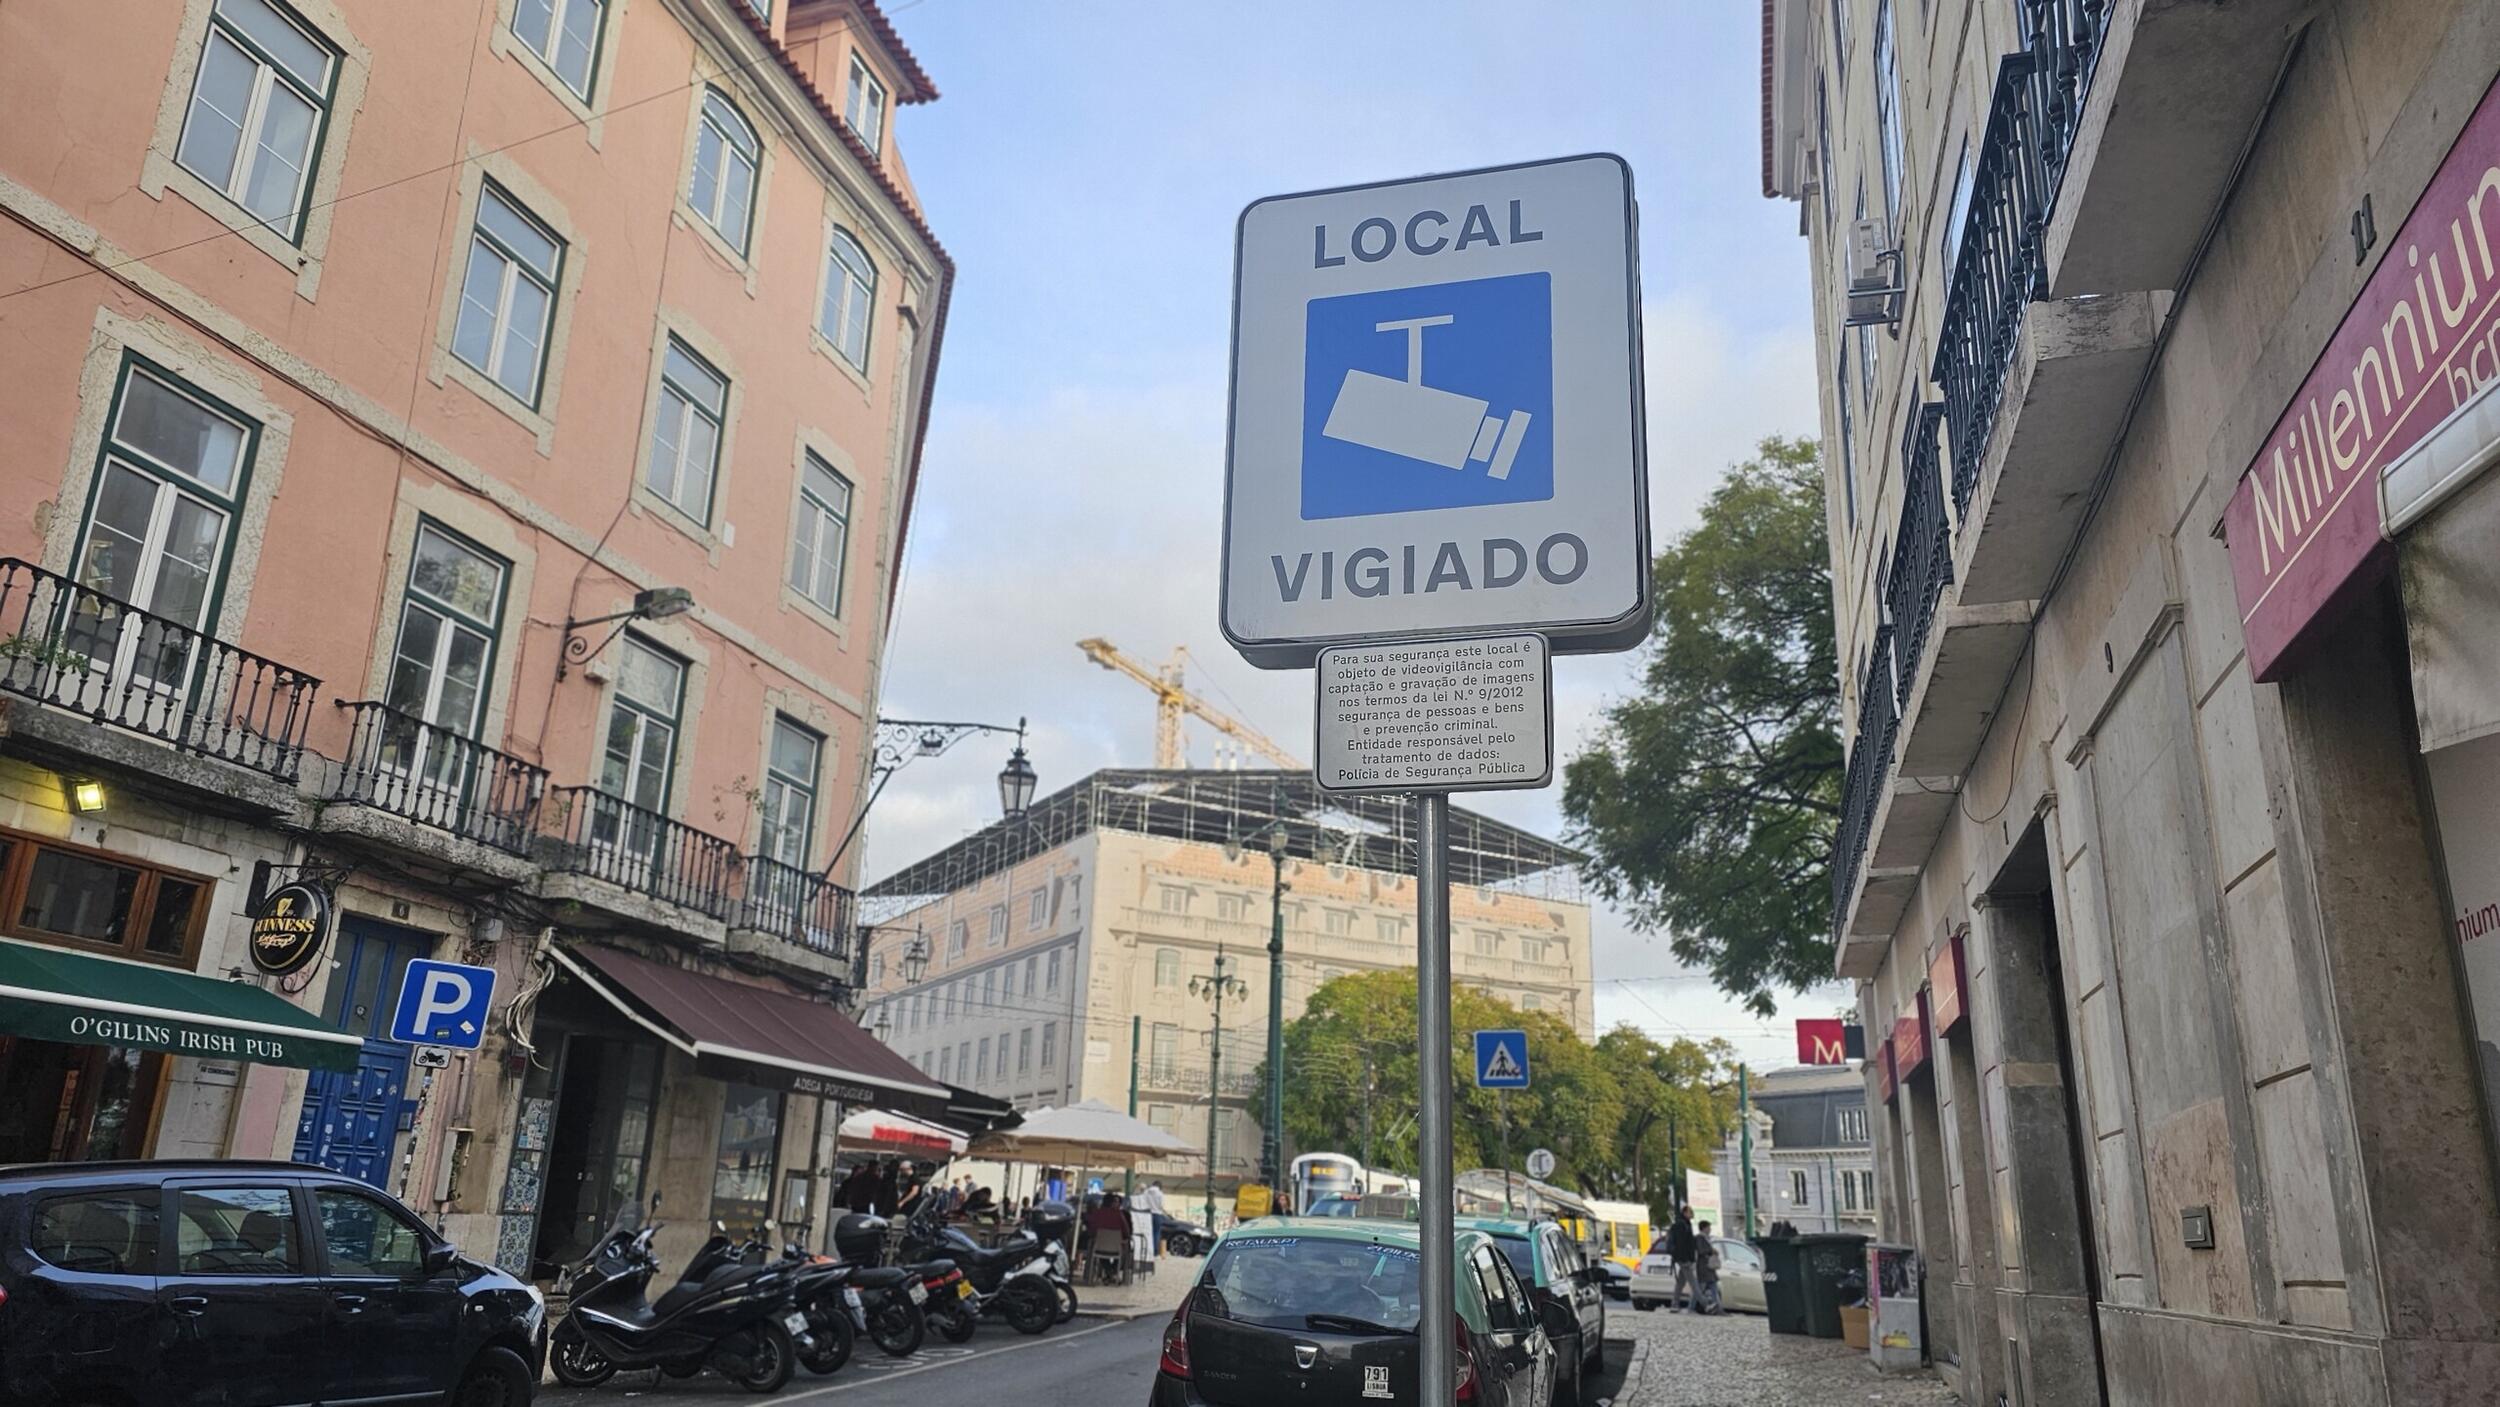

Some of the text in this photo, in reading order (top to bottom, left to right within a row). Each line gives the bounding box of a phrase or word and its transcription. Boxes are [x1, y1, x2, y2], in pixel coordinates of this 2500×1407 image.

[1314, 199, 1544, 269] LOCAL
[2351, 193, 2377, 266] 11
[1271, 532, 1589, 602] VIGIADO
[1333, 642, 1530, 665] Para sua segurança este local é
[1338, 659, 1524, 680] objeto de videovigilância com
[1329, 681, 1383, 695] captação
[1401, 677, 1456, 691] gravação
[1463, 676, 1477, 685] de
[1483, 673, 1534, 684] imagens
[1339, 699, 1360, 707] nos
[1366, 695, 1407, 705] termos
[1413, 693, 1428, 703] da
[1433, 692, 1448, 702] lei
[1479, 687, 1523, 700] 9/2012
[1339, 710, 1400, 723] segurança
[1406, 708, 1420, 718] de
[1427, 706, 1476, 718] pessoas
[1495, 703, 1524, 713] bens
[1376, 723, 1439, 737] prevenção
[1445, 719, 1498, 731] criminal.
[1348, 733, 1515, 751] Entidade responsável pelo
[1362, 750, 1500, 764] tratamento de dados:
[1339, 763, 1525, 780] Polícia de Segurança Pública
[412, 970, 472, 1035] P
[70, 1016, 284, 1058] O'GILINS IRISH PUB
[1811, 1035, 1844, 1064] M
[1366, 1367, 1387, 1380] 791
